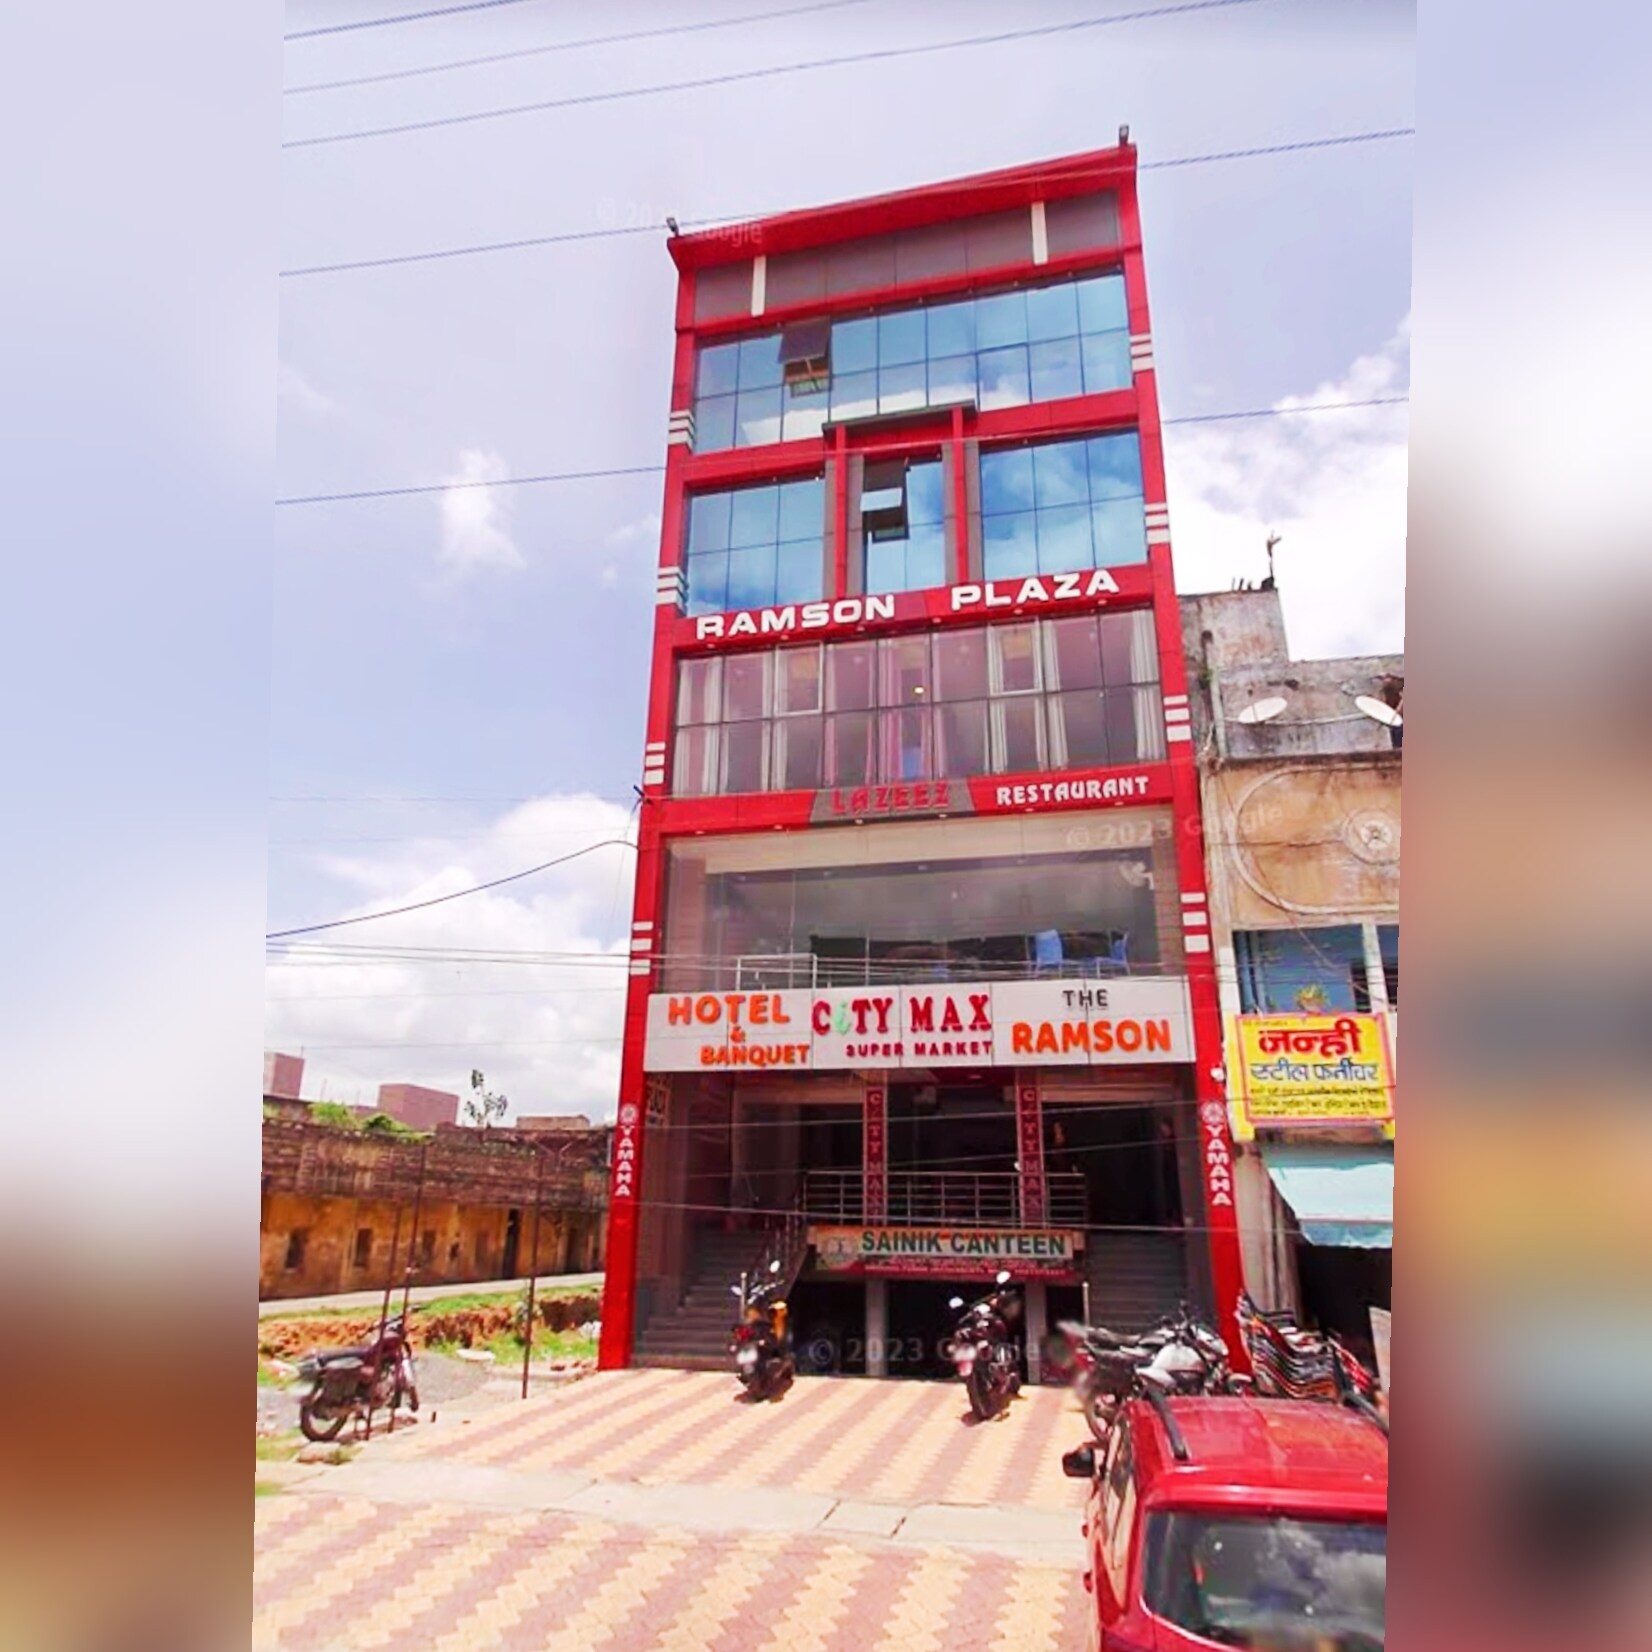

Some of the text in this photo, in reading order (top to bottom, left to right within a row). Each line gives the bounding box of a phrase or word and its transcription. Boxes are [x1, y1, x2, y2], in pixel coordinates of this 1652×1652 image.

[696, 570, 1120, 639] RAMSON PLAZA
[831, 777, 1149, 815] LAZEEZ RESTAURANT
[668, 994, 791, 1025] HOTEL
[909, 994, 992, 1033] MAX
[1063, 989, 1108, 1008] THE
[730, 1026, 746, 1042] &
[846, 1040, 992, 1058] SUPER MARKET
[1012, 1019, 1172, 1055] RAMSON
[700, 1044, 811, 1067] BANQUET
[615, 1125, 636, 1197] YAMAHA
[1205, 1124, 1233, 1206] YAMAHA
[861, 1231, 1066, 1254] SAINIK CANTEEN
